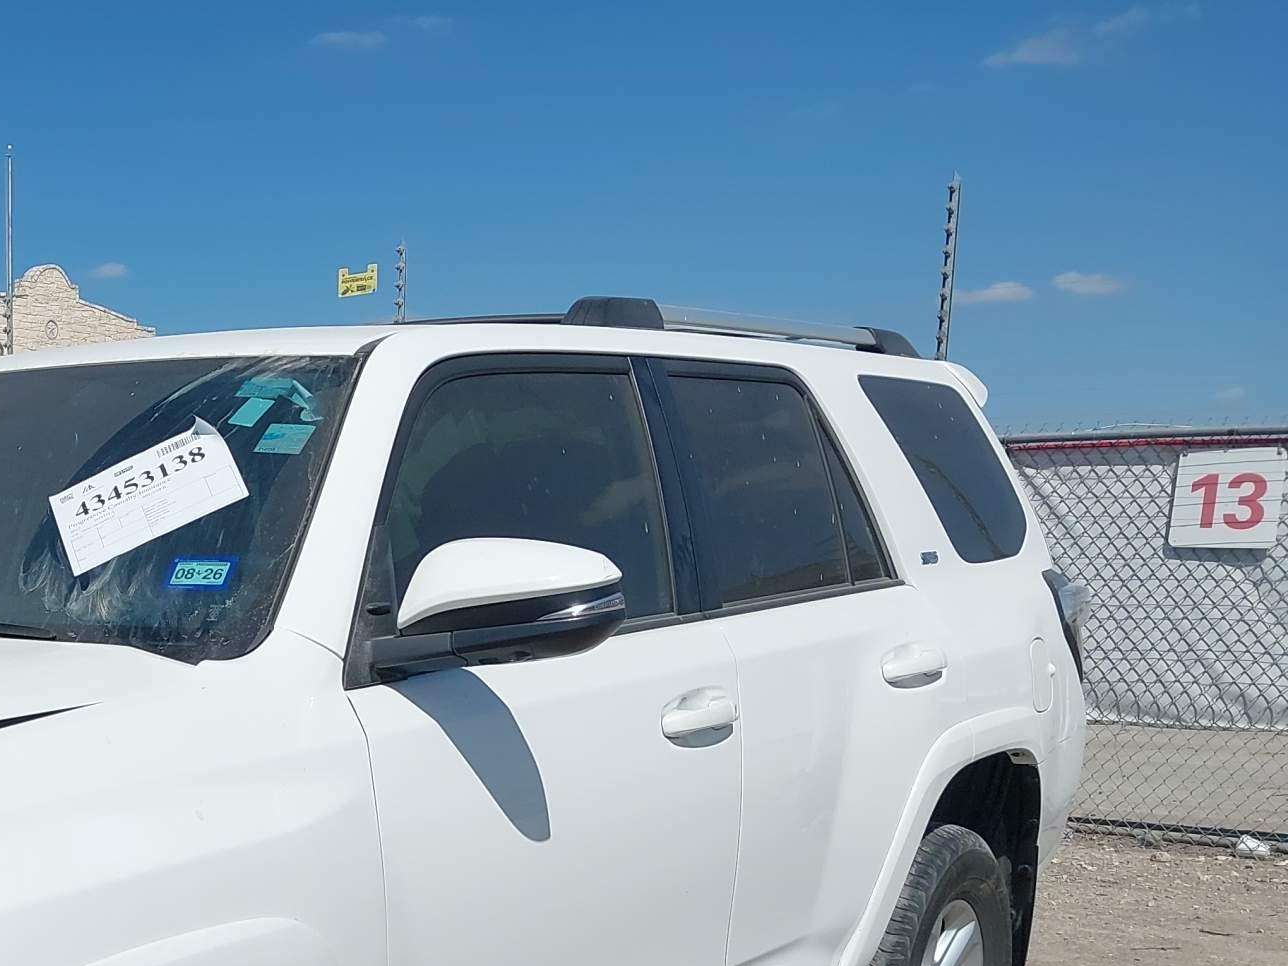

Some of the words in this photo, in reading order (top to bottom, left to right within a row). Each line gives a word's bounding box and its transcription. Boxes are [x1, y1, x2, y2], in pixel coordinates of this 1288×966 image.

[75, 446, 206, 517] 43453138
[1191, 472, 1268, 530] 13
[175, 568, 196, 580] 08
[201, 568, 224, 580] 26
